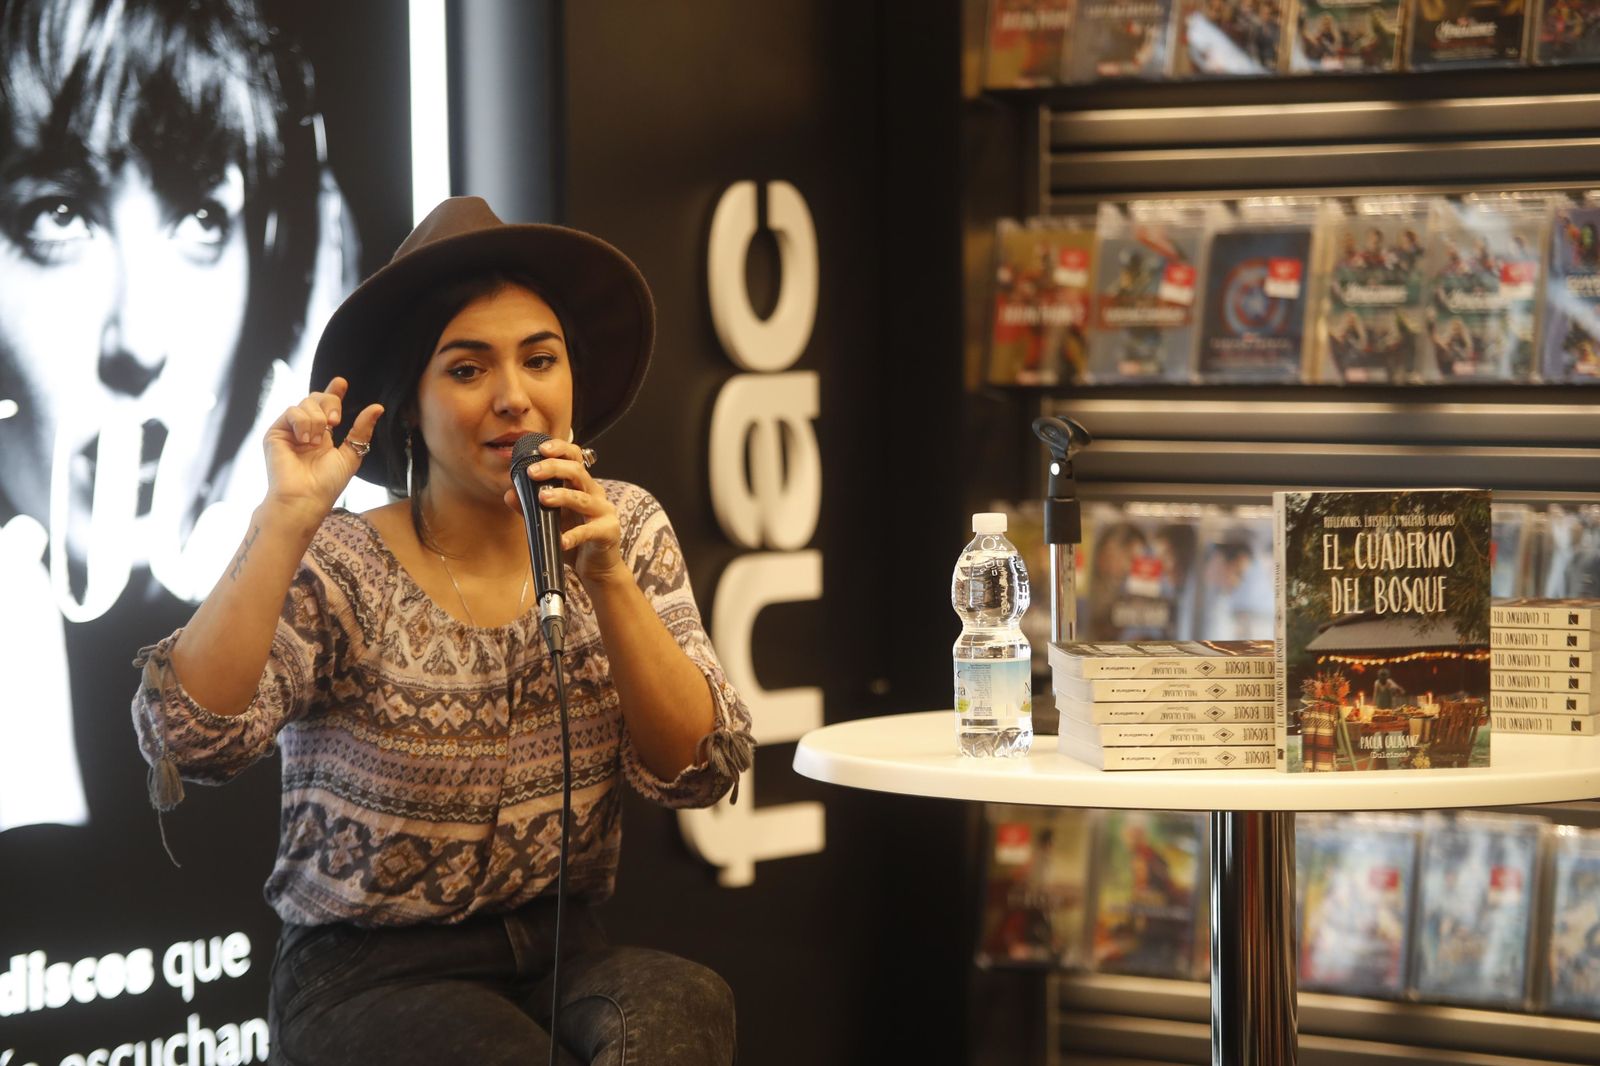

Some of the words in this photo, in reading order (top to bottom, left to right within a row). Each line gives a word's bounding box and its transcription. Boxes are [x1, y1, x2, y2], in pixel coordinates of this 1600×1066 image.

[677, 180, 827, 888] fnac
[1323, 534, 1344, 570] EL
[1354, 531, 1455, 570] CUADERNO
[1332, 577, 1364, 614] DEL
[1375, 576, 1447, 614] BOSQUE
[0, 950, 155, 1017] discos
[162, 932, 251, 1003] que
[59, 1012, 269, 1066] cuchan
